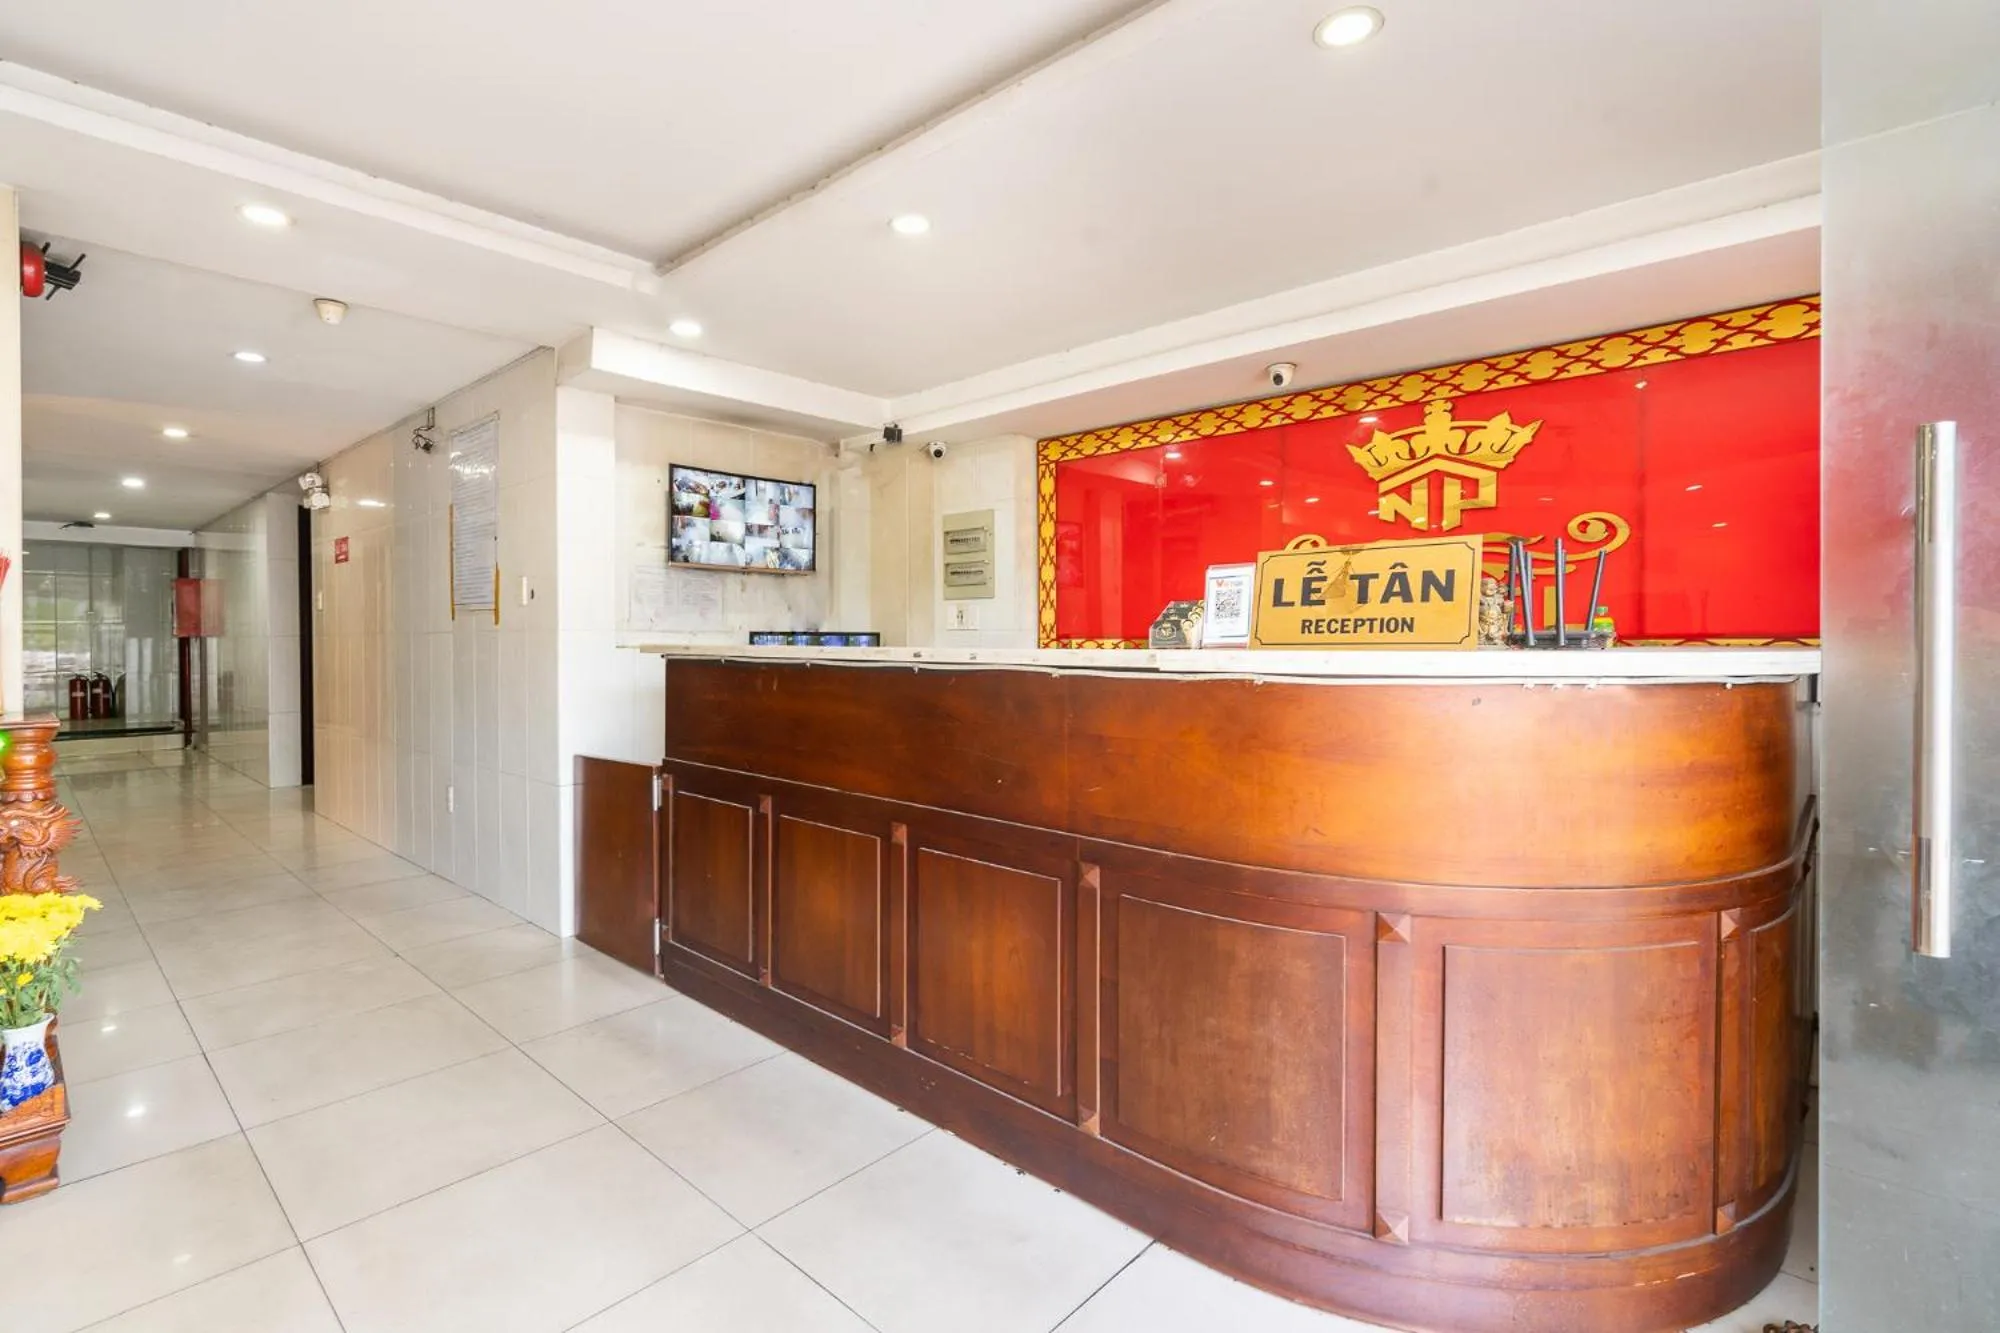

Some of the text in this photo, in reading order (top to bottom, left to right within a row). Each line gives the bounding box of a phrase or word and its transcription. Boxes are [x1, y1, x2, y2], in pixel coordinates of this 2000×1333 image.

[1272, 560, 1456, 608] LỄ TÂN
[1300, 616, 1415, 635] RECEPTION
